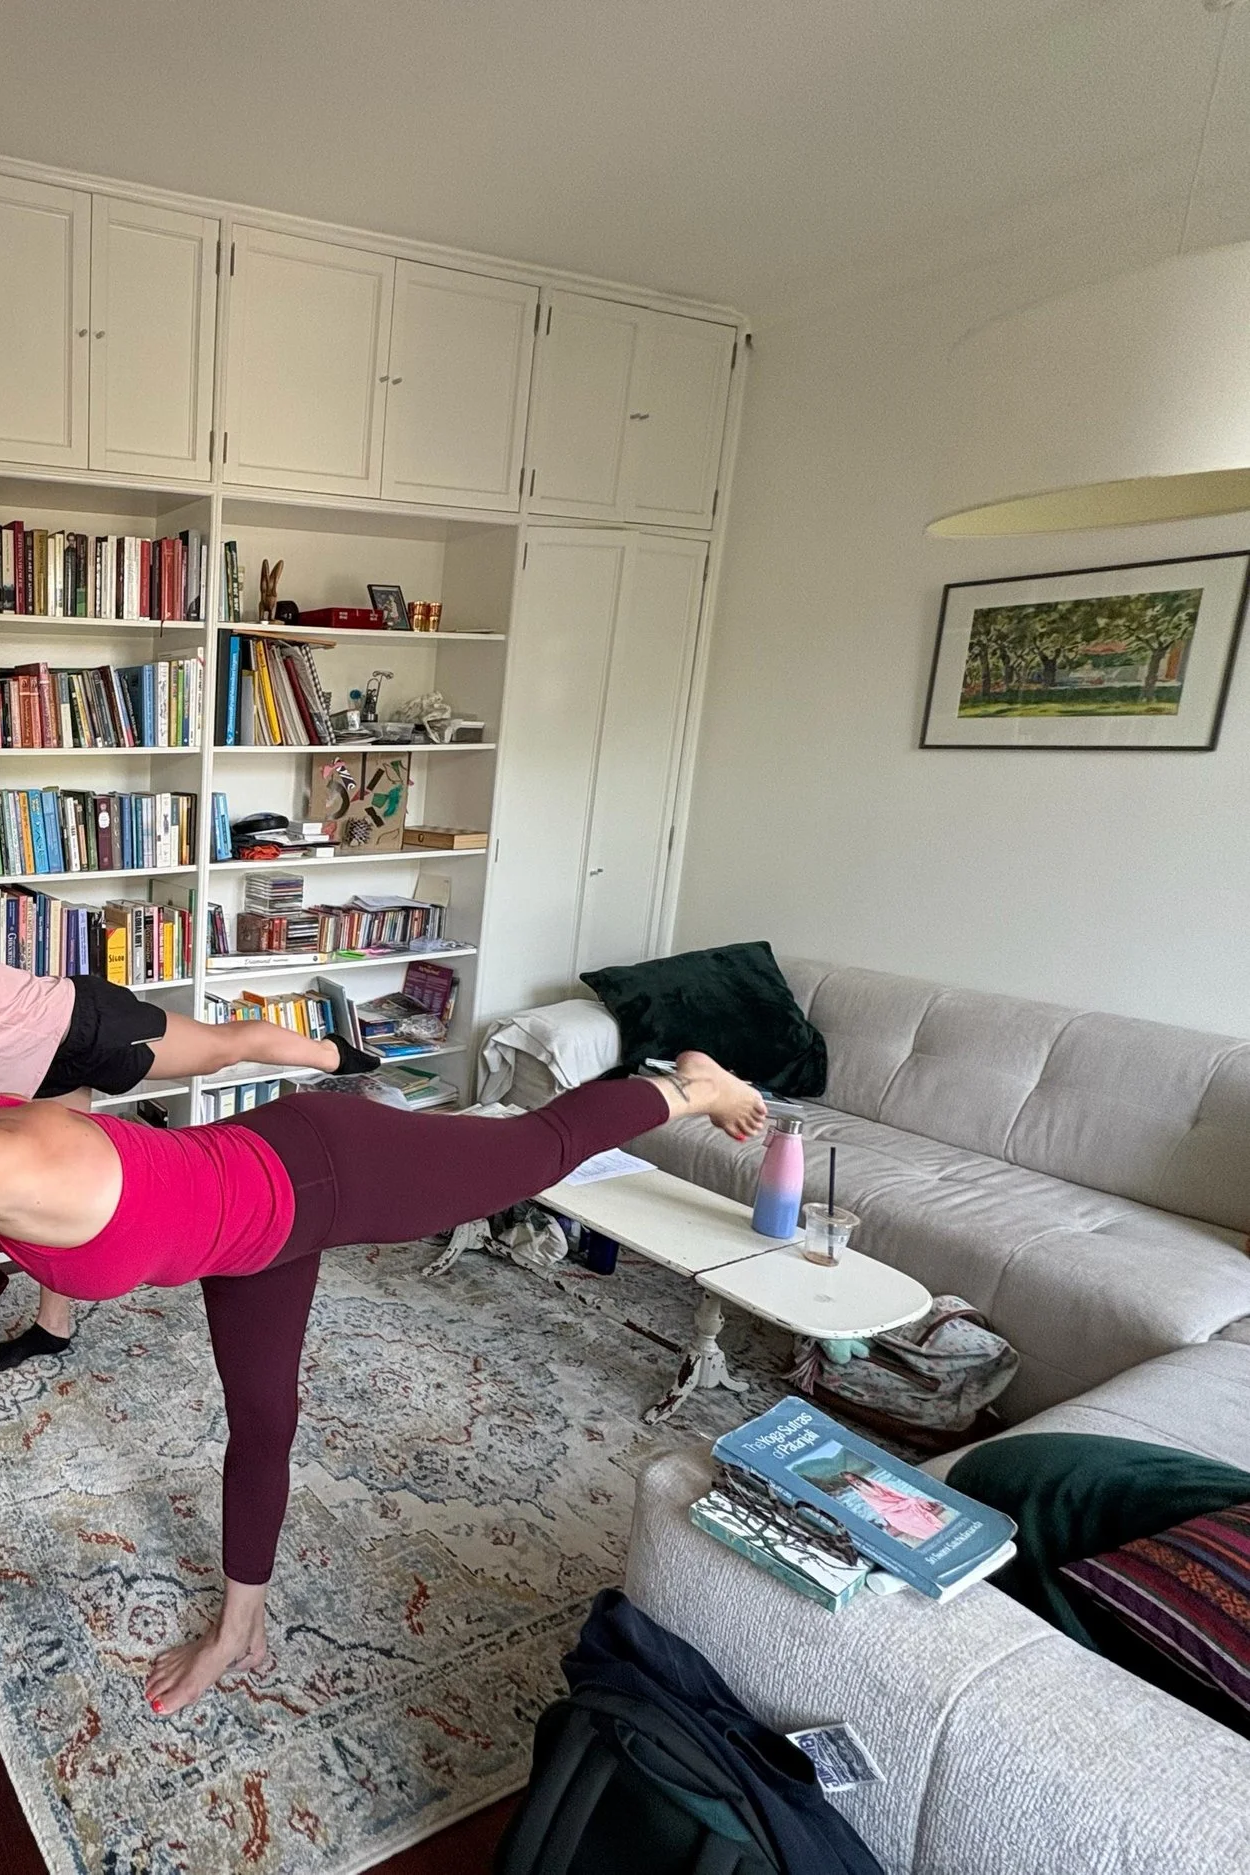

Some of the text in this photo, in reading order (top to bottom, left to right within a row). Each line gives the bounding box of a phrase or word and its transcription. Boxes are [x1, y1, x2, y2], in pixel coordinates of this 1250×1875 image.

[134, 910, 143, 948] GLOBAL RIFT
[742, 1412, 813, 1454] The Yoga Sutras
[773, 1429, 820, 1459] of Patanjali
